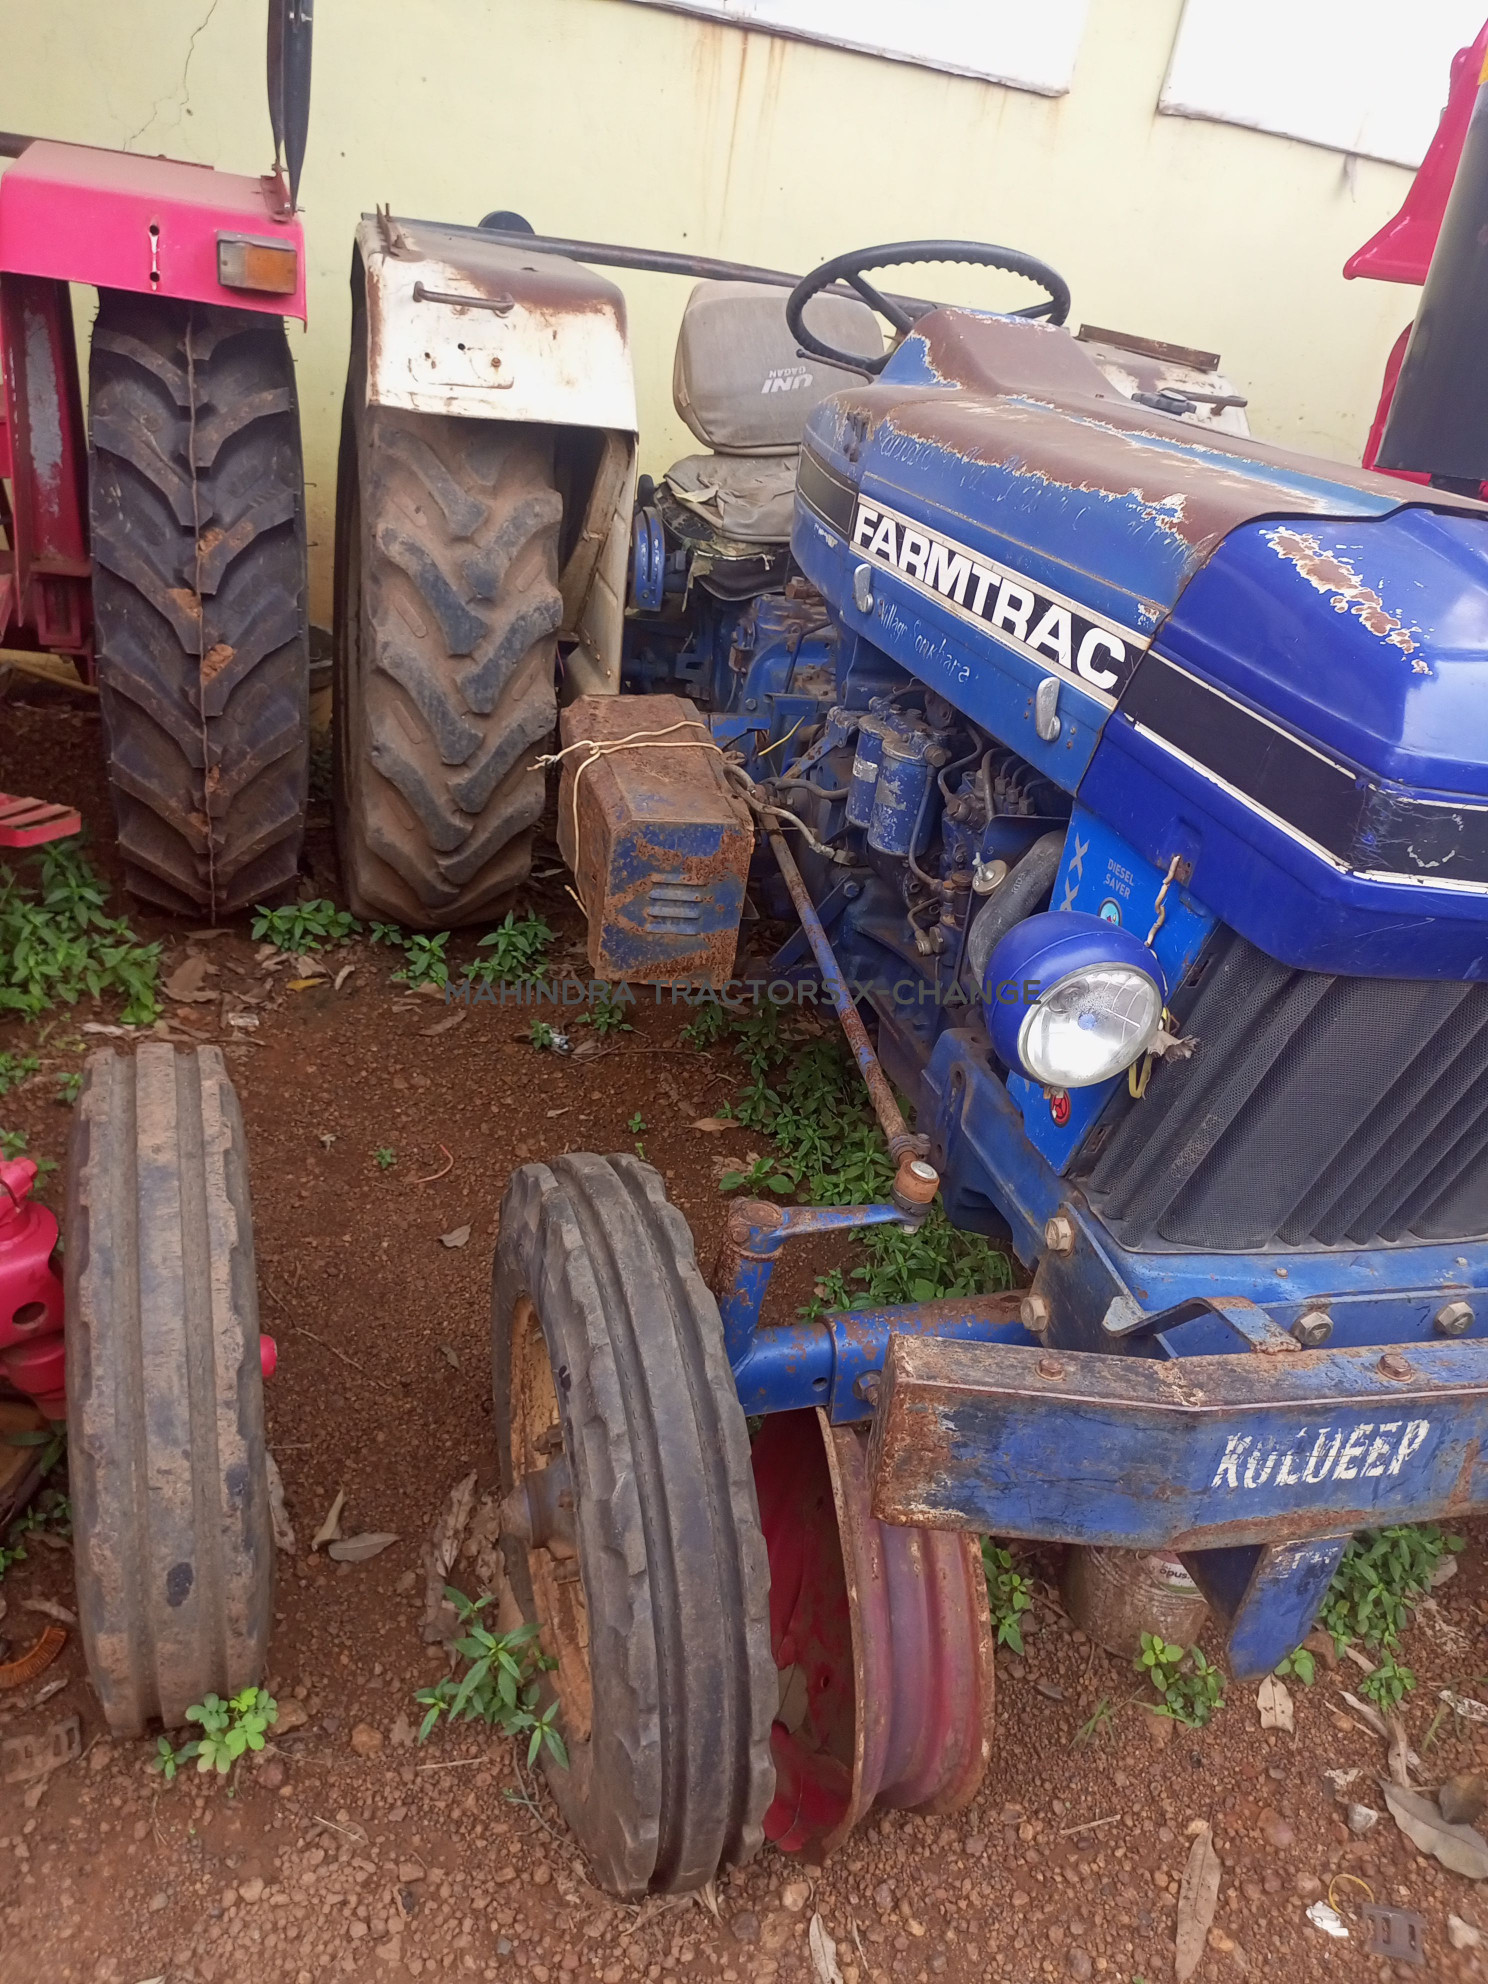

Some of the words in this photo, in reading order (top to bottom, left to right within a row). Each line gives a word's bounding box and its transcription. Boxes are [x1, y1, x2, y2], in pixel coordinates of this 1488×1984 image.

[761, 374, 813, 394] UNI
[853, 510, 1127, 690] FARMTRAC
[1107, 858, 1135, 886] DIESEL
[1104, 874, 1131, 899] SAVER
[1211, 1419, 1430, 1488] KULDEEP
